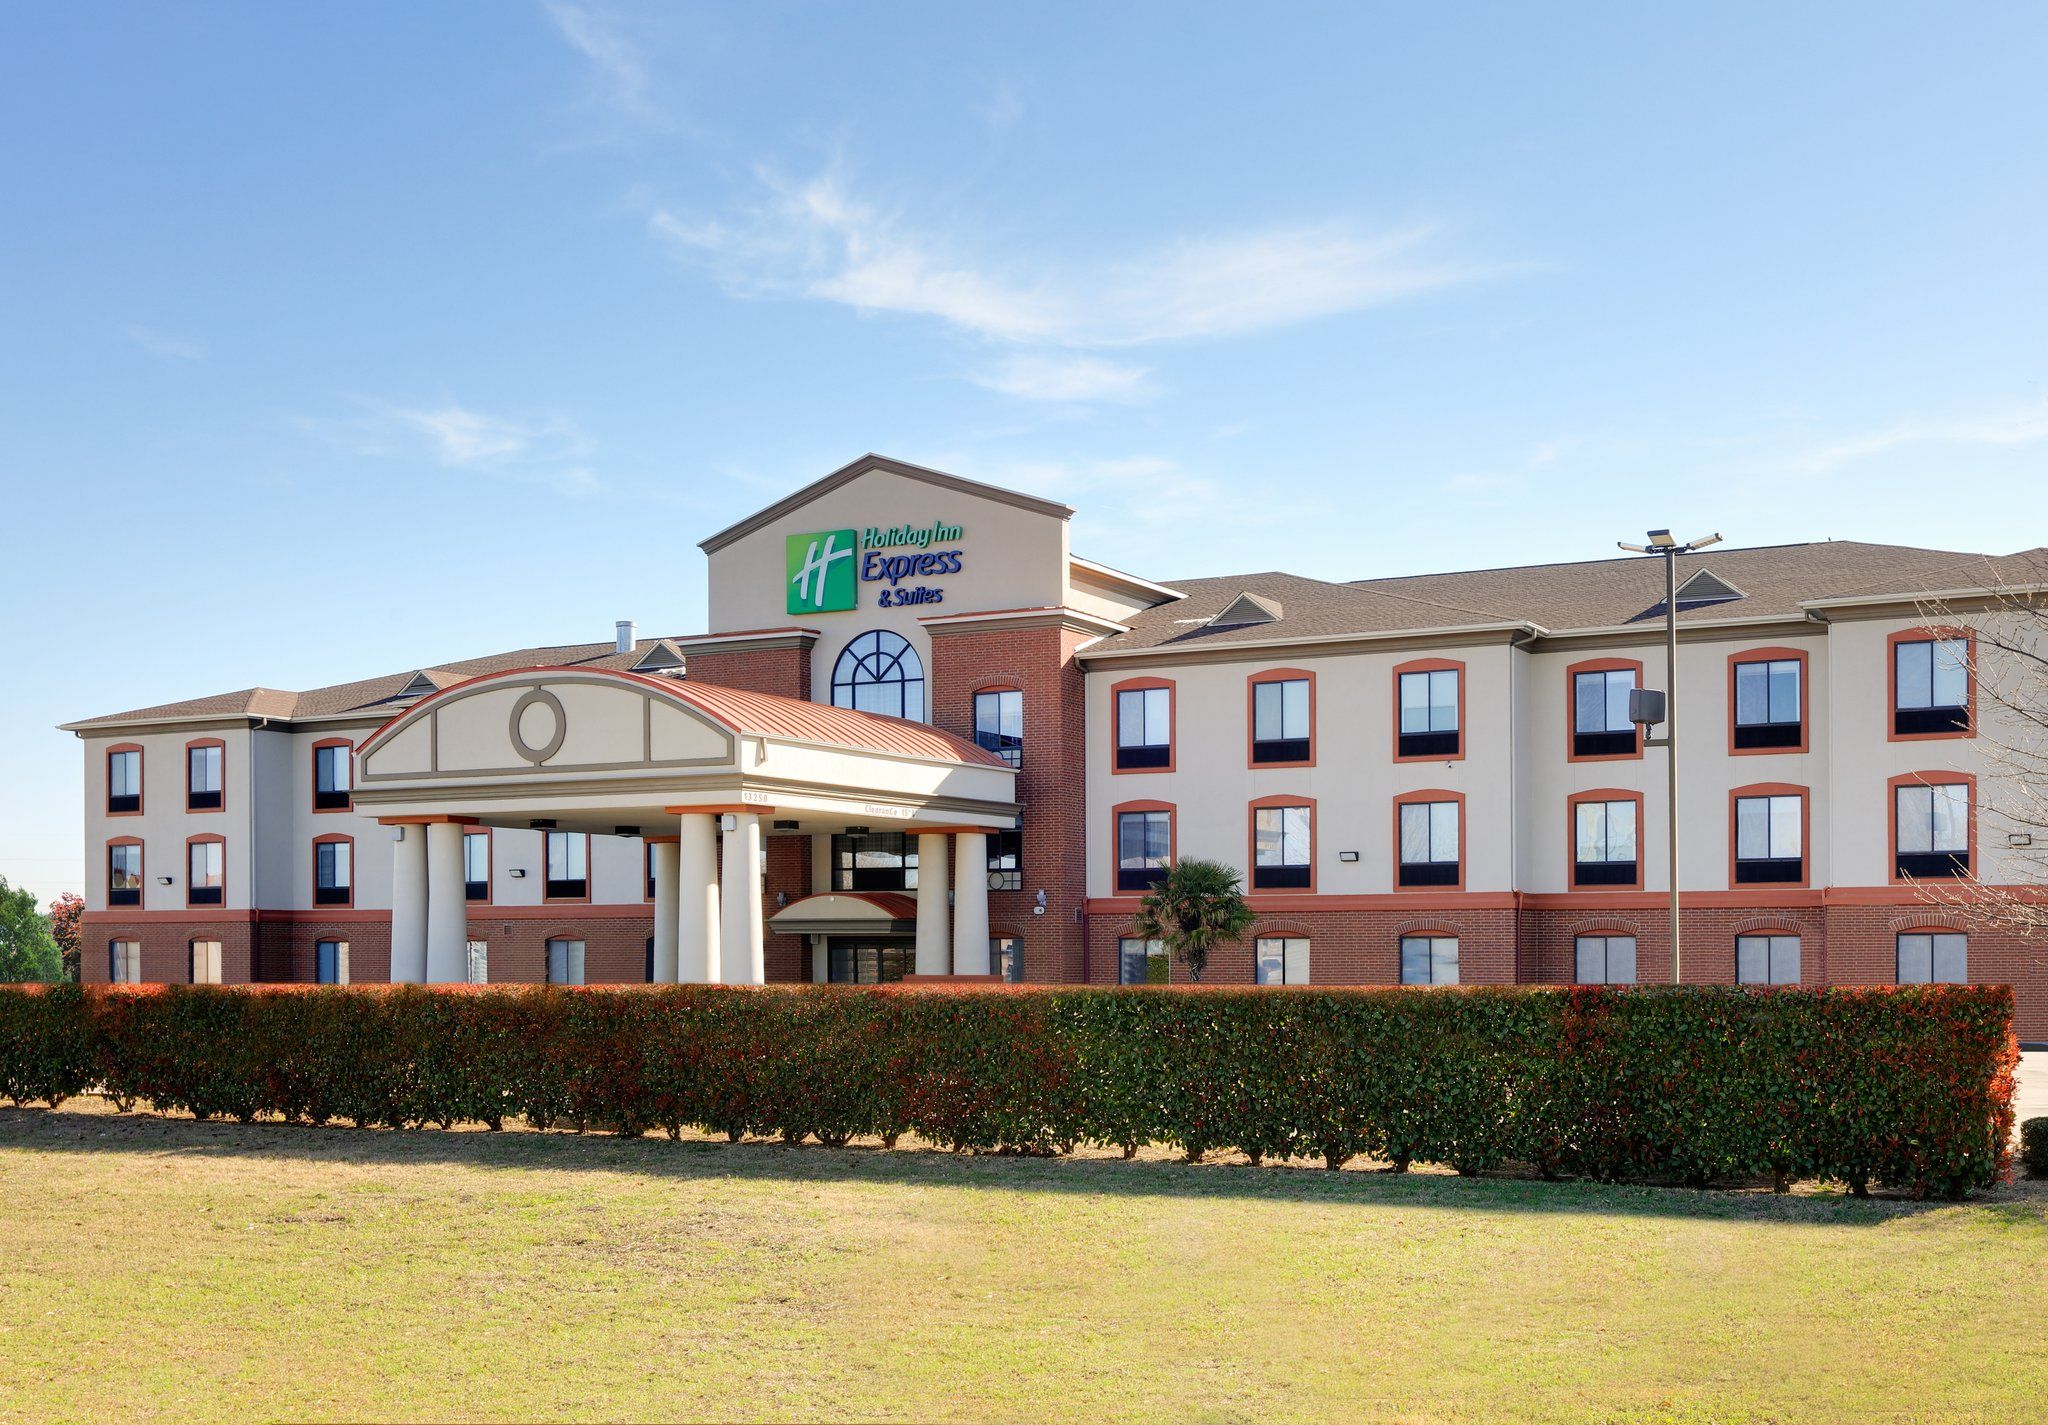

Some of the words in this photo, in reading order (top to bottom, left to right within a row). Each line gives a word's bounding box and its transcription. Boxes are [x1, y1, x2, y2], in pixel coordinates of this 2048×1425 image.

[861, 524, 932, 549] Holiday
[932, 520, 963, 542] Inn
[860, 550, 963, 586] Express
[878, 589, 892, 608] &
[893, 586, 944, 606] Suites
